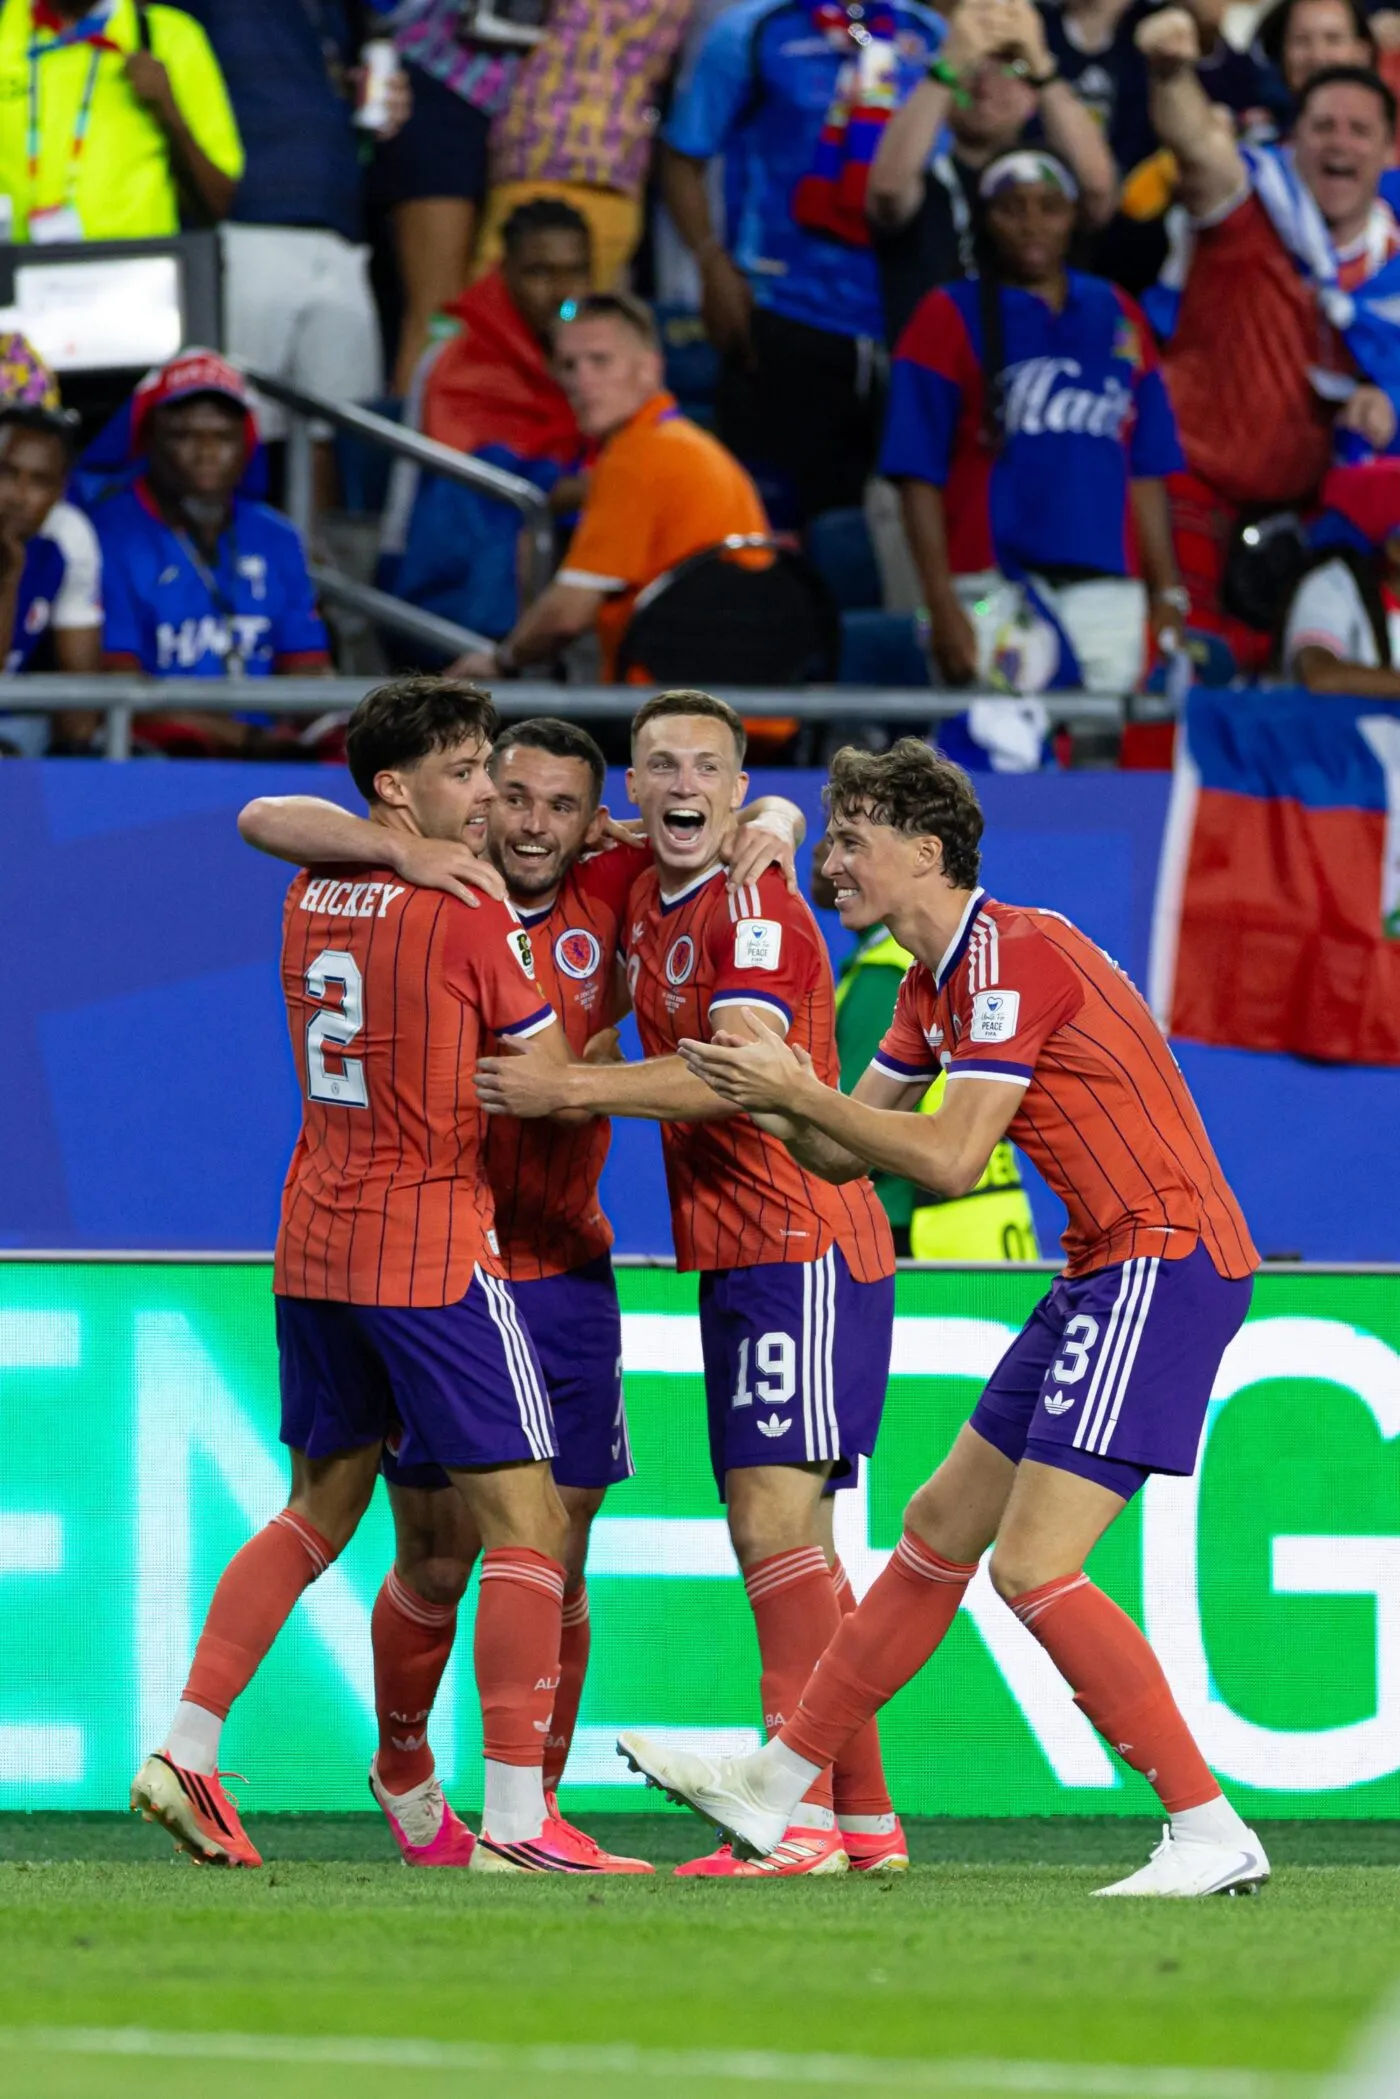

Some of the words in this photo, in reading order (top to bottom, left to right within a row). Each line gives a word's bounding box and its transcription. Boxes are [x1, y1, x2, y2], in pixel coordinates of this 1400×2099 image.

[996, 357, 1137, 440] Hai
[300, 877, 405, 918] HICKEY
[304, 949, 369, 1109] 2
[981, 1021, 1003, 1031] PEACE
[730, 1331, 796, 1410] 19
[1044, 1314, 1100, 1386] 3
